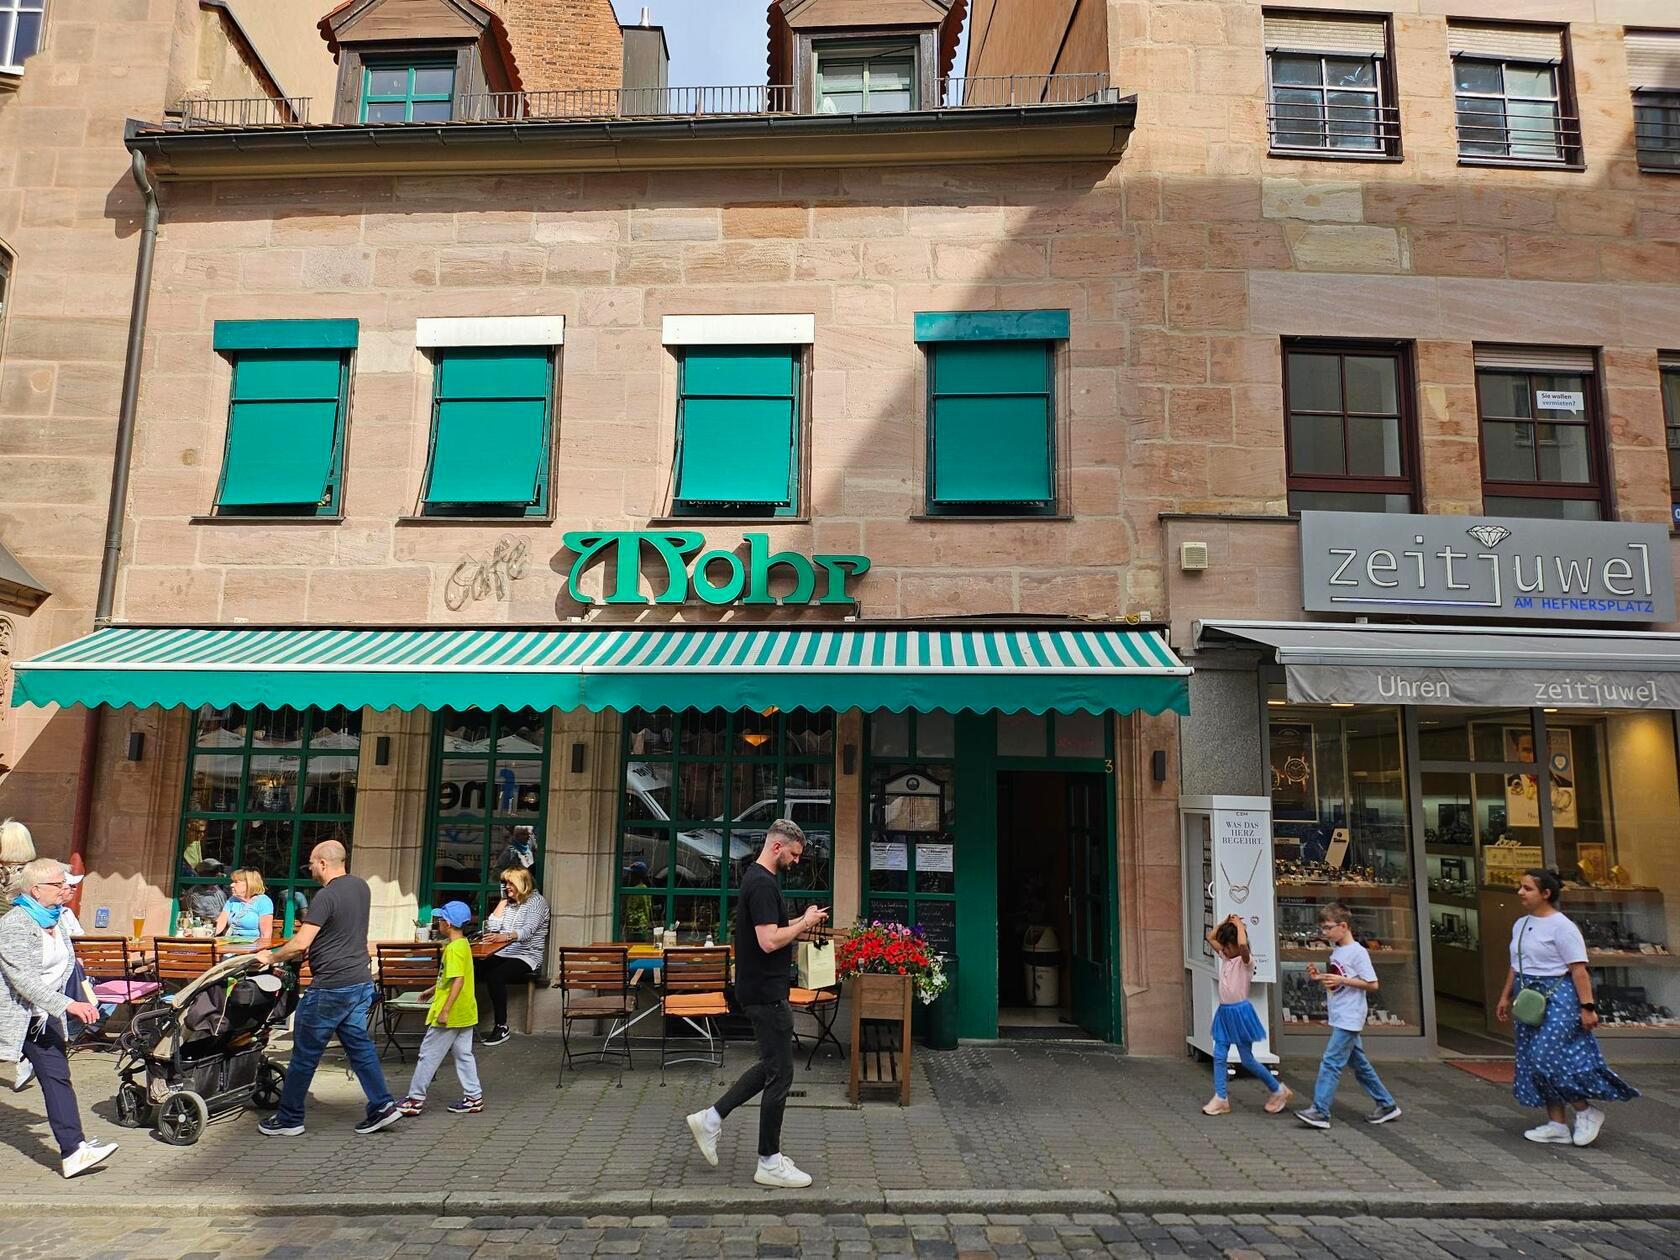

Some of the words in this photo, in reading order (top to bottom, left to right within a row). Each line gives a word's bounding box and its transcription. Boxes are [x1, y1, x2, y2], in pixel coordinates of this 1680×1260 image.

[562, 530, 872, 605] Mohr
[1328, 534, 1654, 607] zeitjuwel
[1513, 597, 1534, 608] AM
[1542, 598, 1654, 613] HEFNERSPLATZ
[1377, 675, 1451, 698] Uhren
[1533, 679, 1658, 706] zeitjuwel
[1104, 759, 1113, 773] 3
